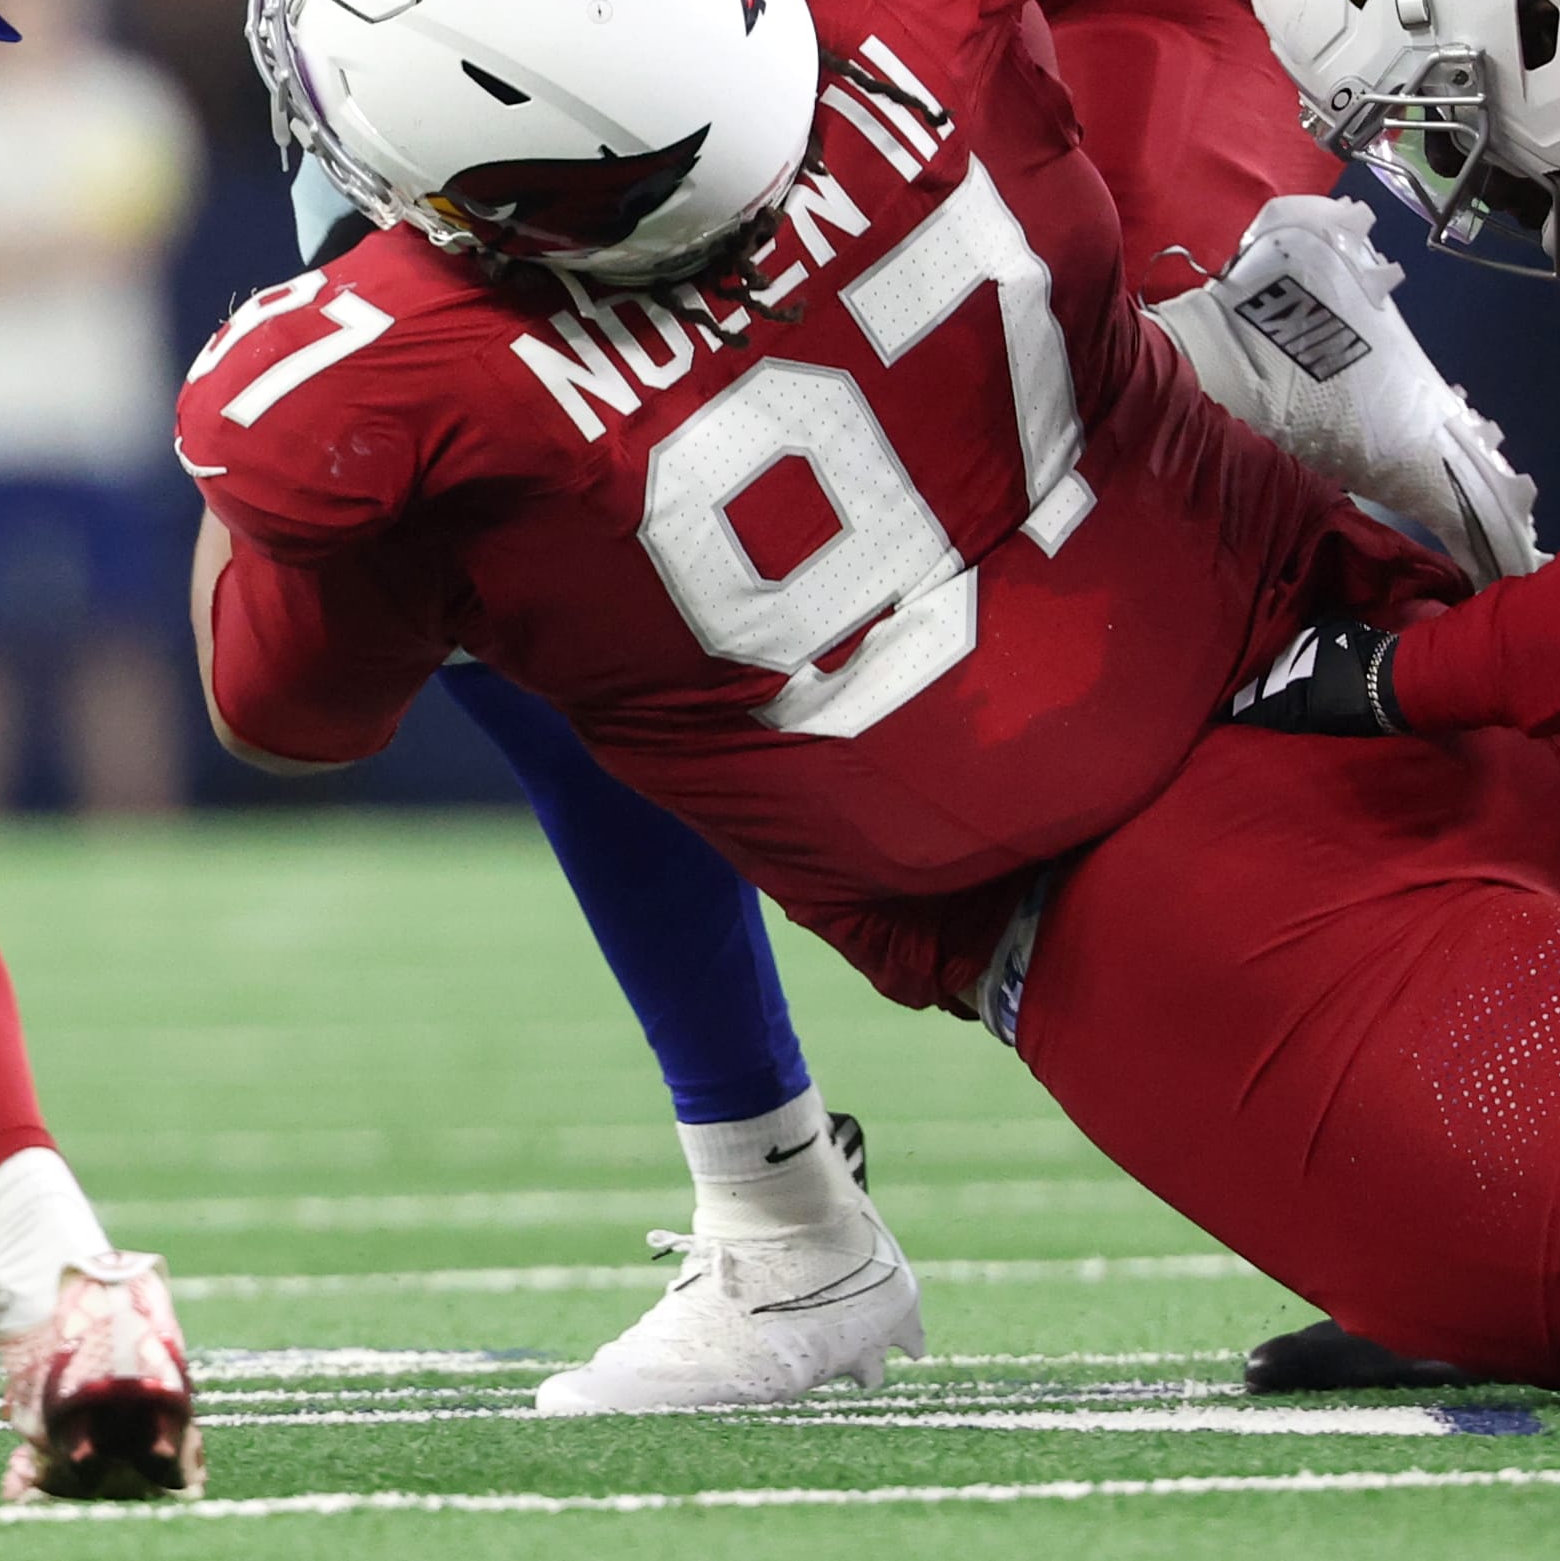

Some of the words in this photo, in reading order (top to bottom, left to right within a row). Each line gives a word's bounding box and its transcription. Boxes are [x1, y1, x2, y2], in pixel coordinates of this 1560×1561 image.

[186, 268, 396, 428] 97
[1235, 274, 1372, 383] NIKE
[638, 151, 1097, 738] 97
